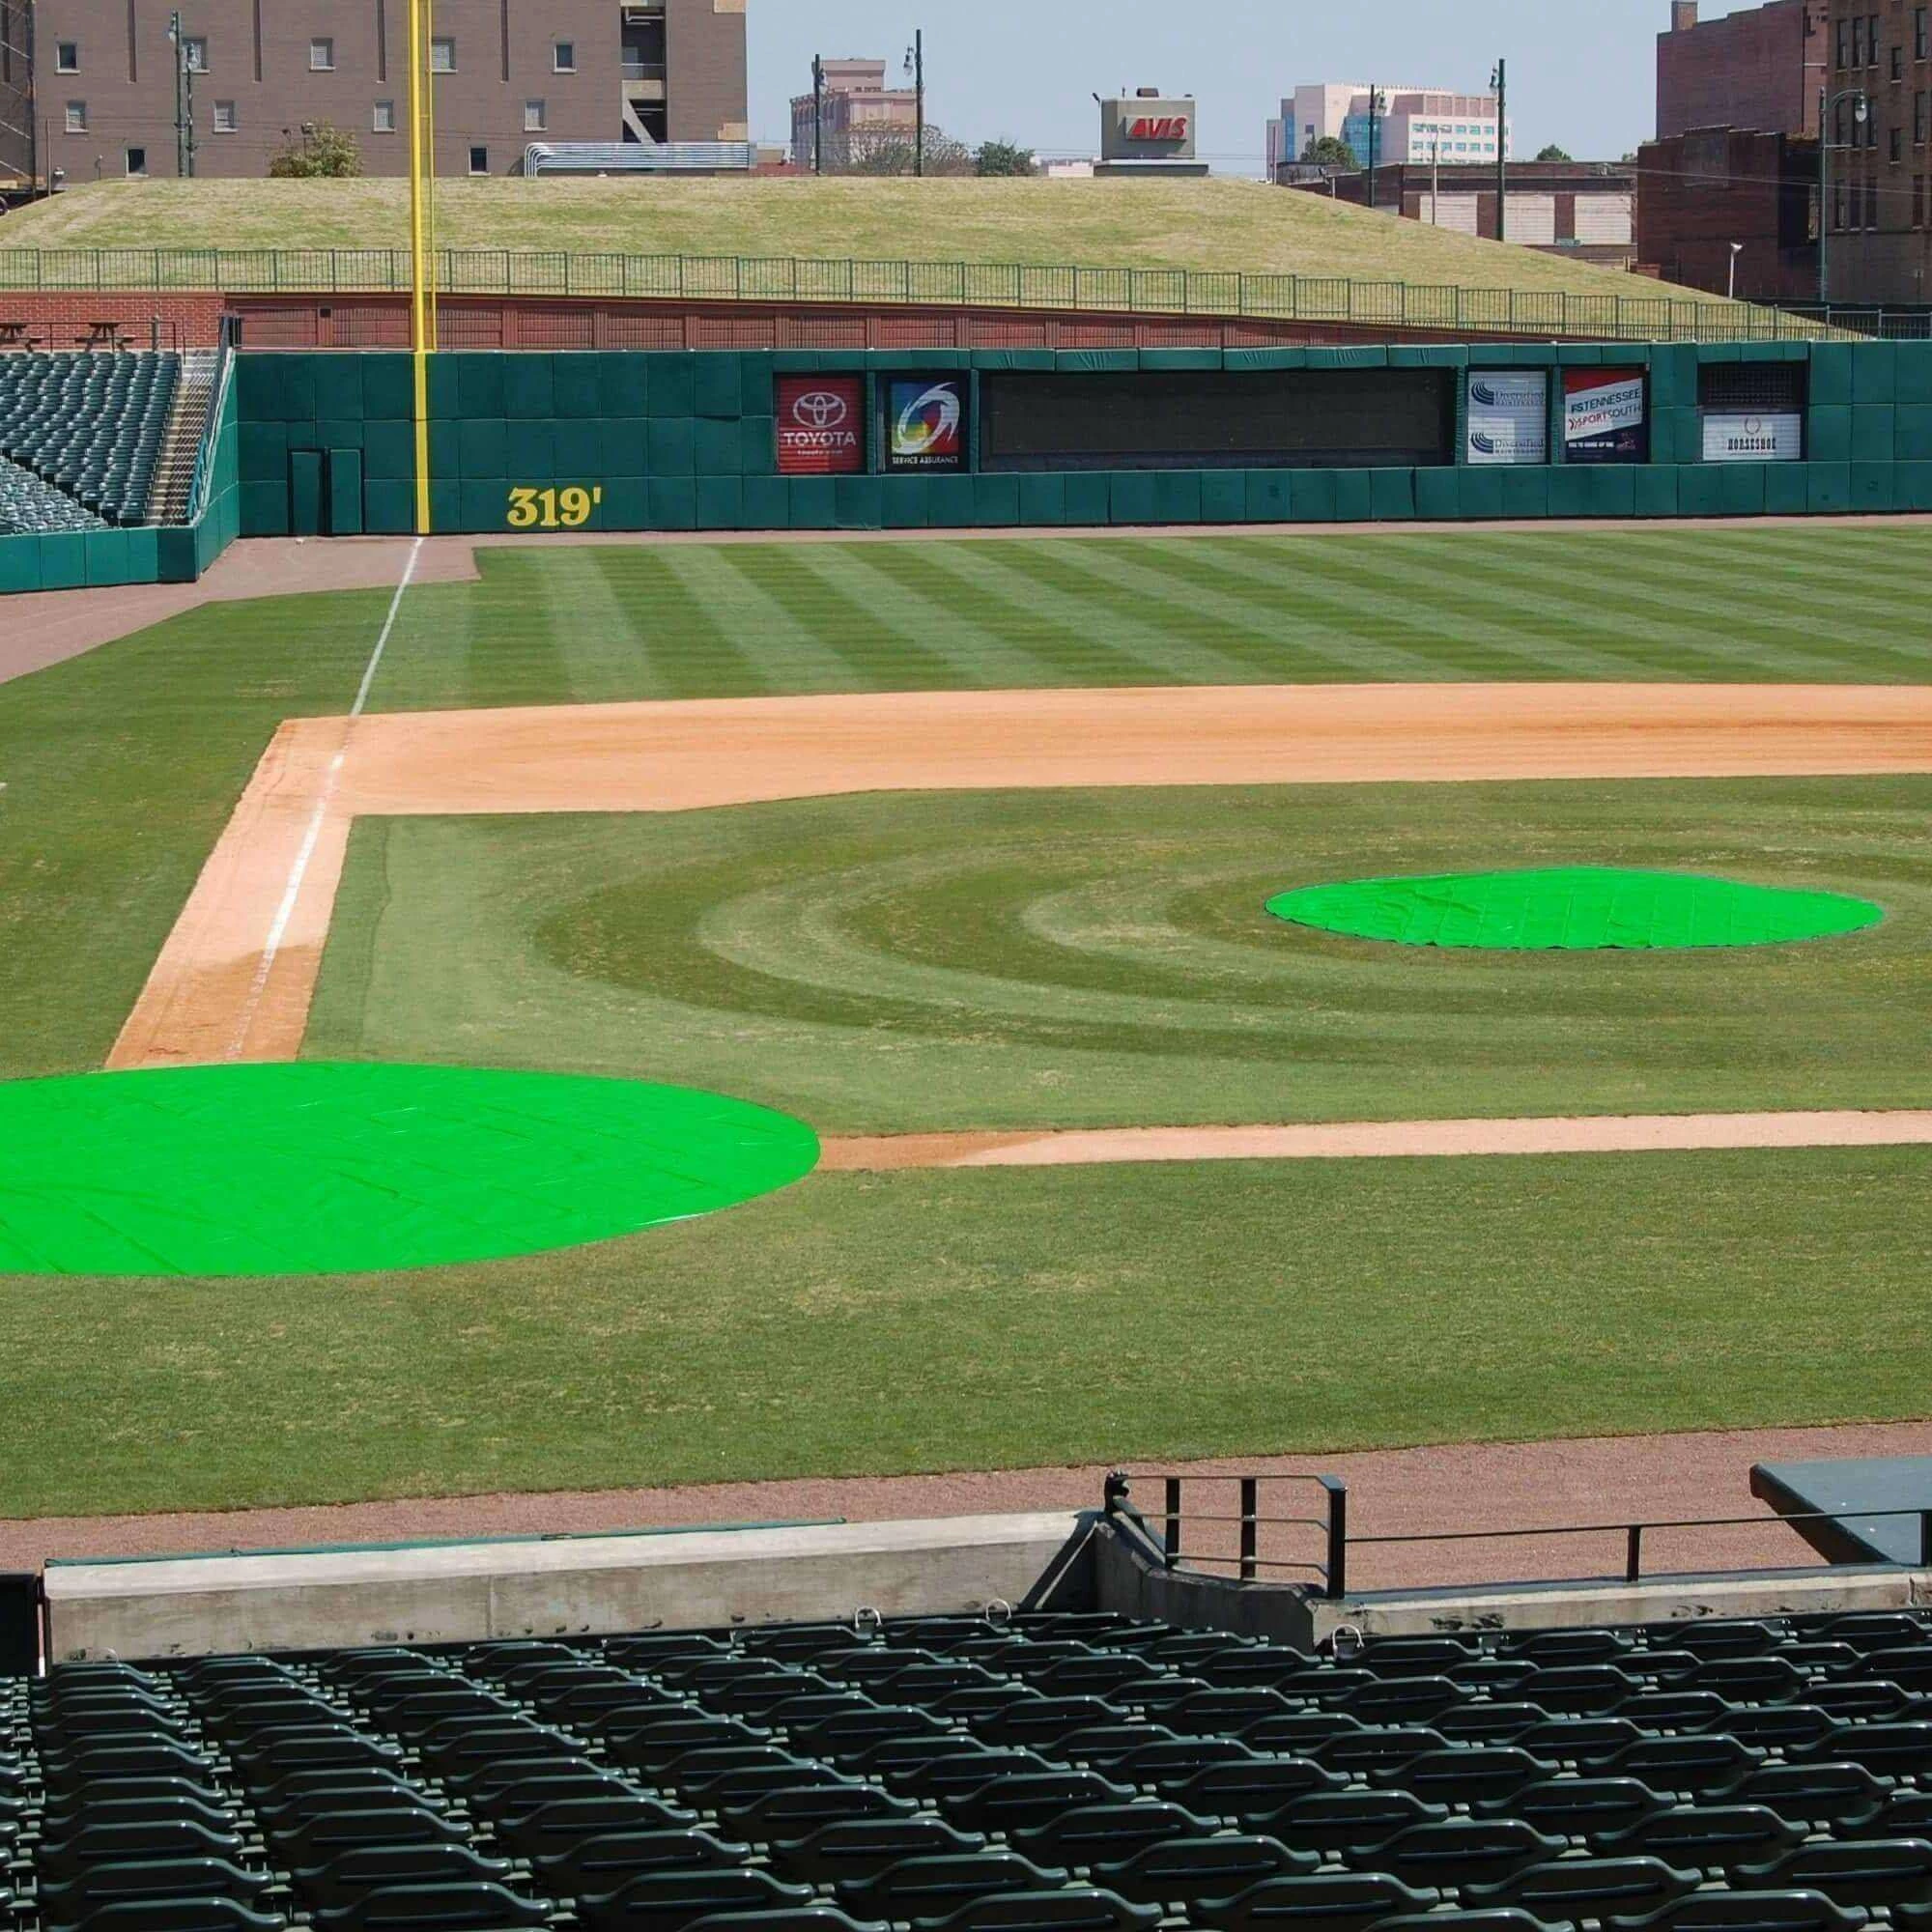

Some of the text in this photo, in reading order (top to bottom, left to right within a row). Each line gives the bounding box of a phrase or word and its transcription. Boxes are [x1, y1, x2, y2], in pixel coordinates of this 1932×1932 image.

[1131, 118, 1187, 139] AVIS
[783, 432, 856, 446] TOYOTA
[507, 487, 601, 526] 319'
